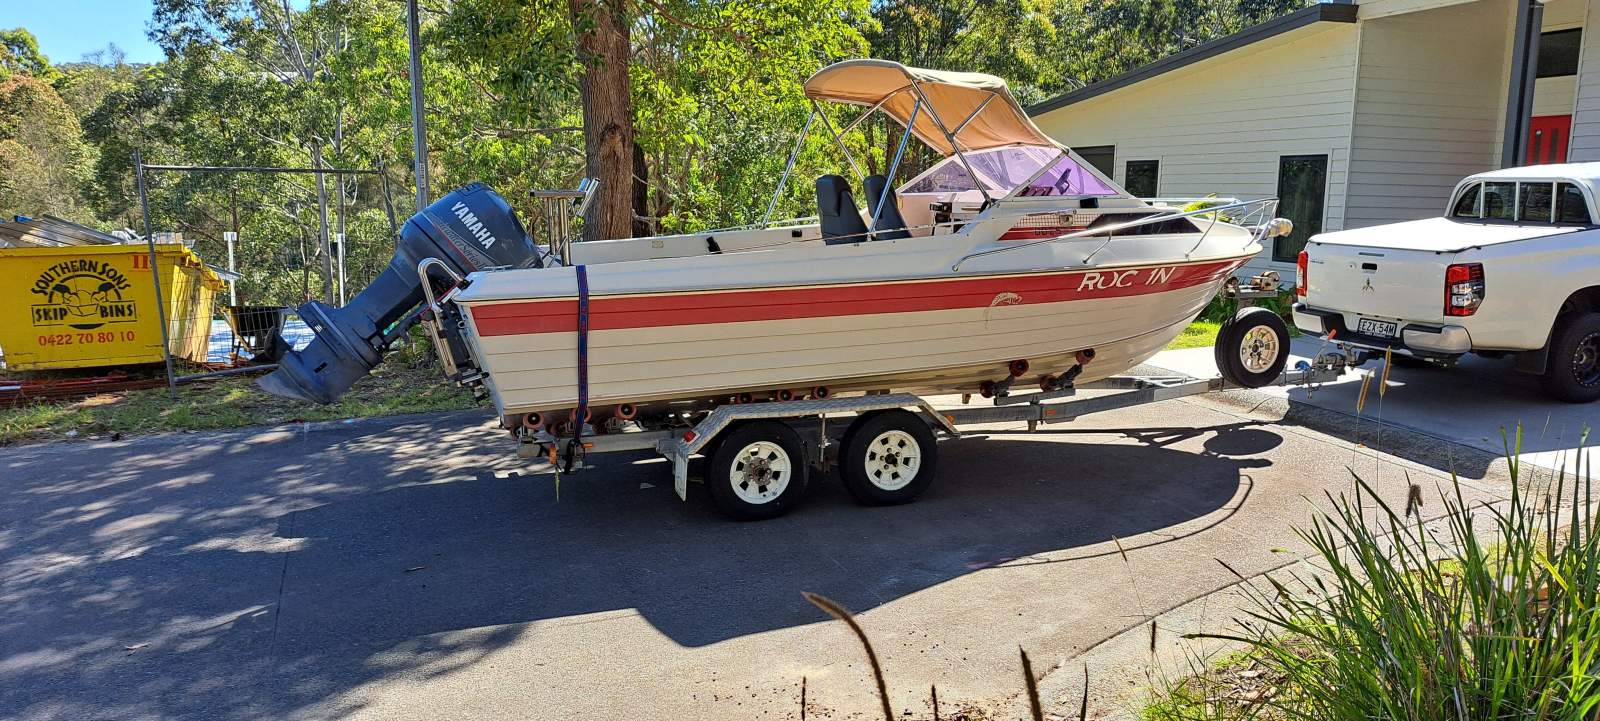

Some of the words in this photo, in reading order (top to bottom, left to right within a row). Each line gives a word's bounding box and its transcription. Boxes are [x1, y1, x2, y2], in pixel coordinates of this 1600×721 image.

[451, 201, 496, 249] YAMAHA
[31, 259, 98, 296] SOUTHERN
[99, 262, 131, 290] SONS
[35, 307, 68, 322] SKIP
[100, 304, 134, 318] BINS
[38, 334, 73, 346] 0422
[77, 333, 94, 344] 70
[98, 331, 115, 342] 80
[120, 331, 135, 342] 10
